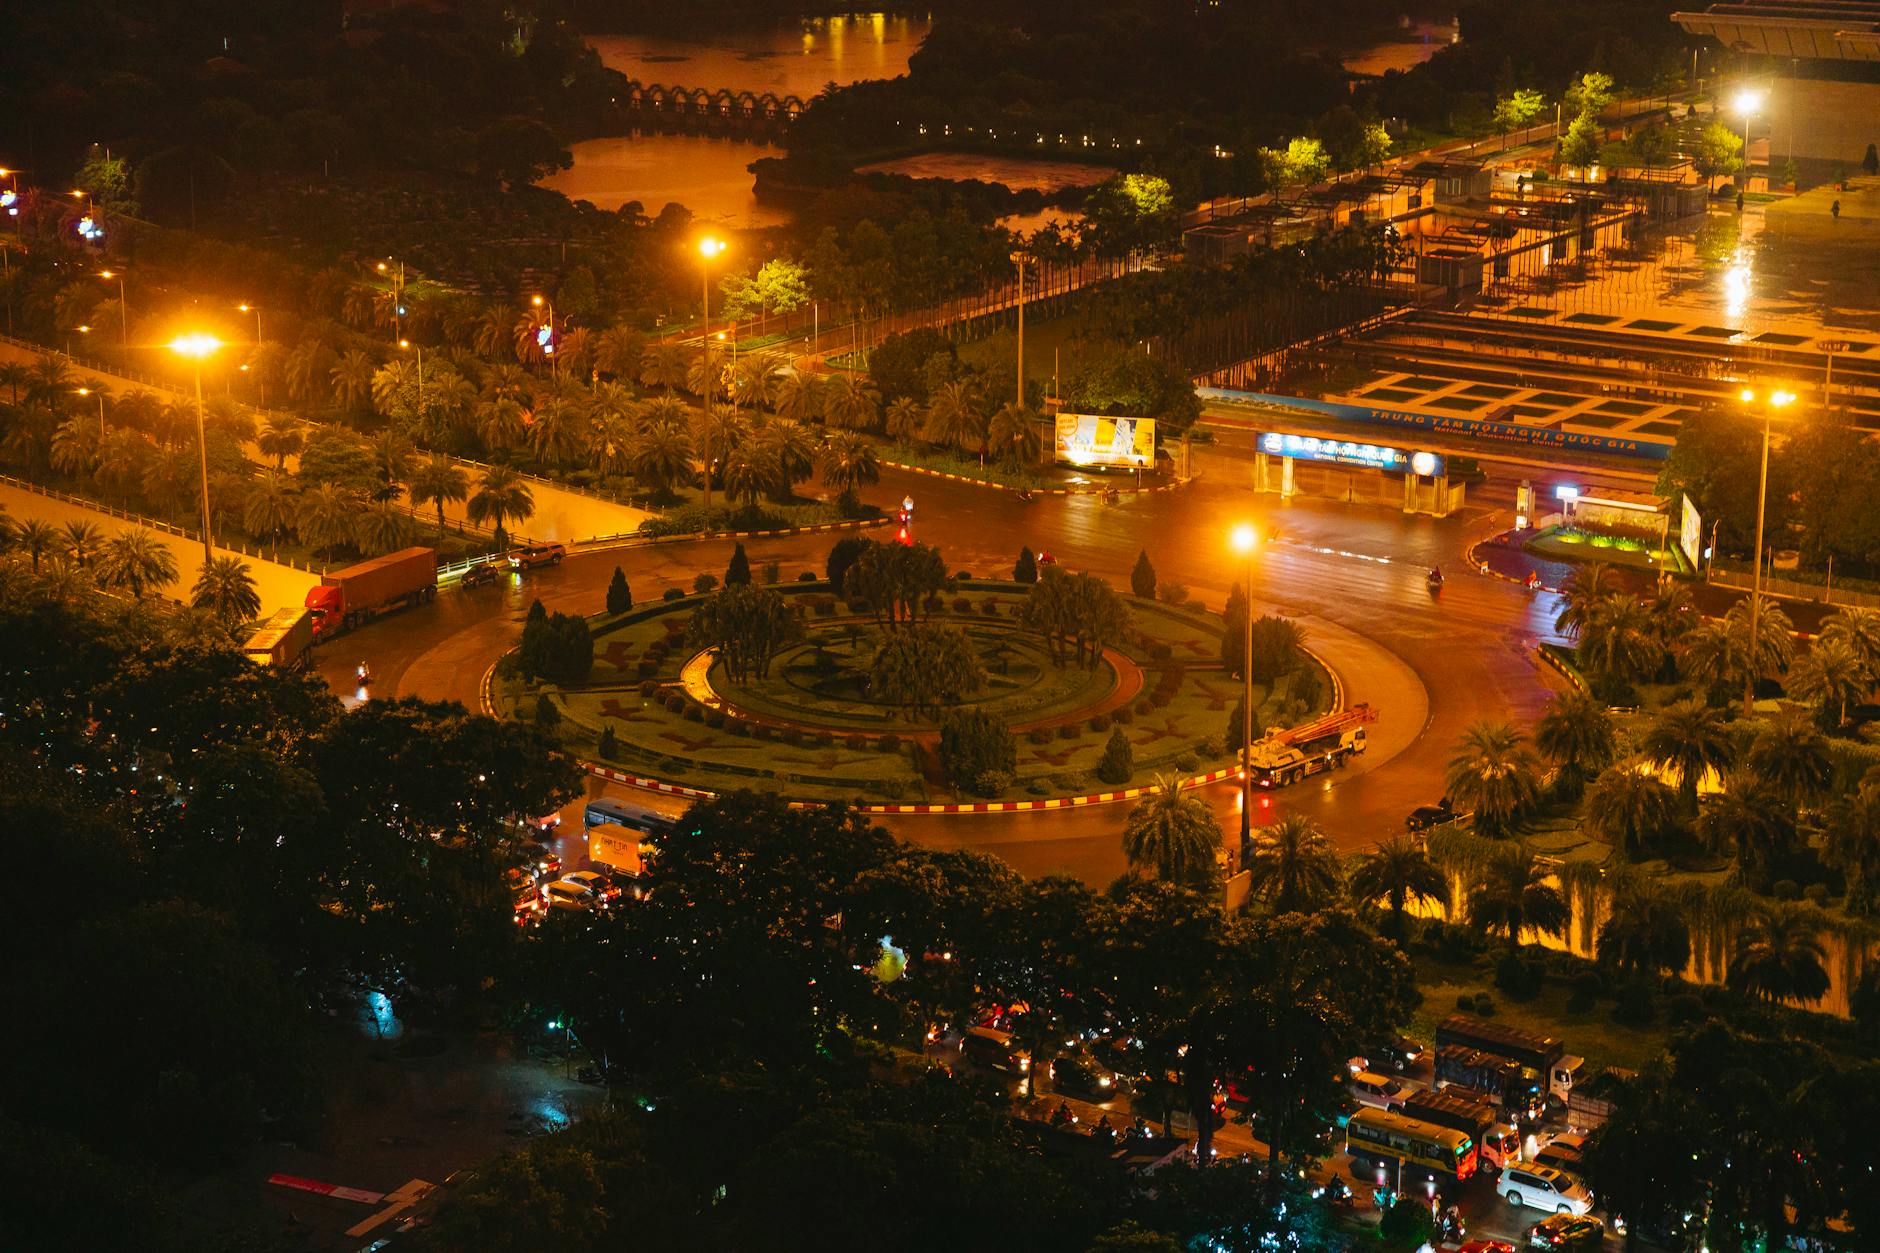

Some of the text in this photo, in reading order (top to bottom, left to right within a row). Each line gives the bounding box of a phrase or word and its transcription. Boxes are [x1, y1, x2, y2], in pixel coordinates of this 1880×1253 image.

[1371, 410, 1425, 424] TRUNG
[1607, 440, 1637, 450] GIA
[1433, 426, 1564, 448] National Convention Center
[1394, 453, 1408, 465] GIA
